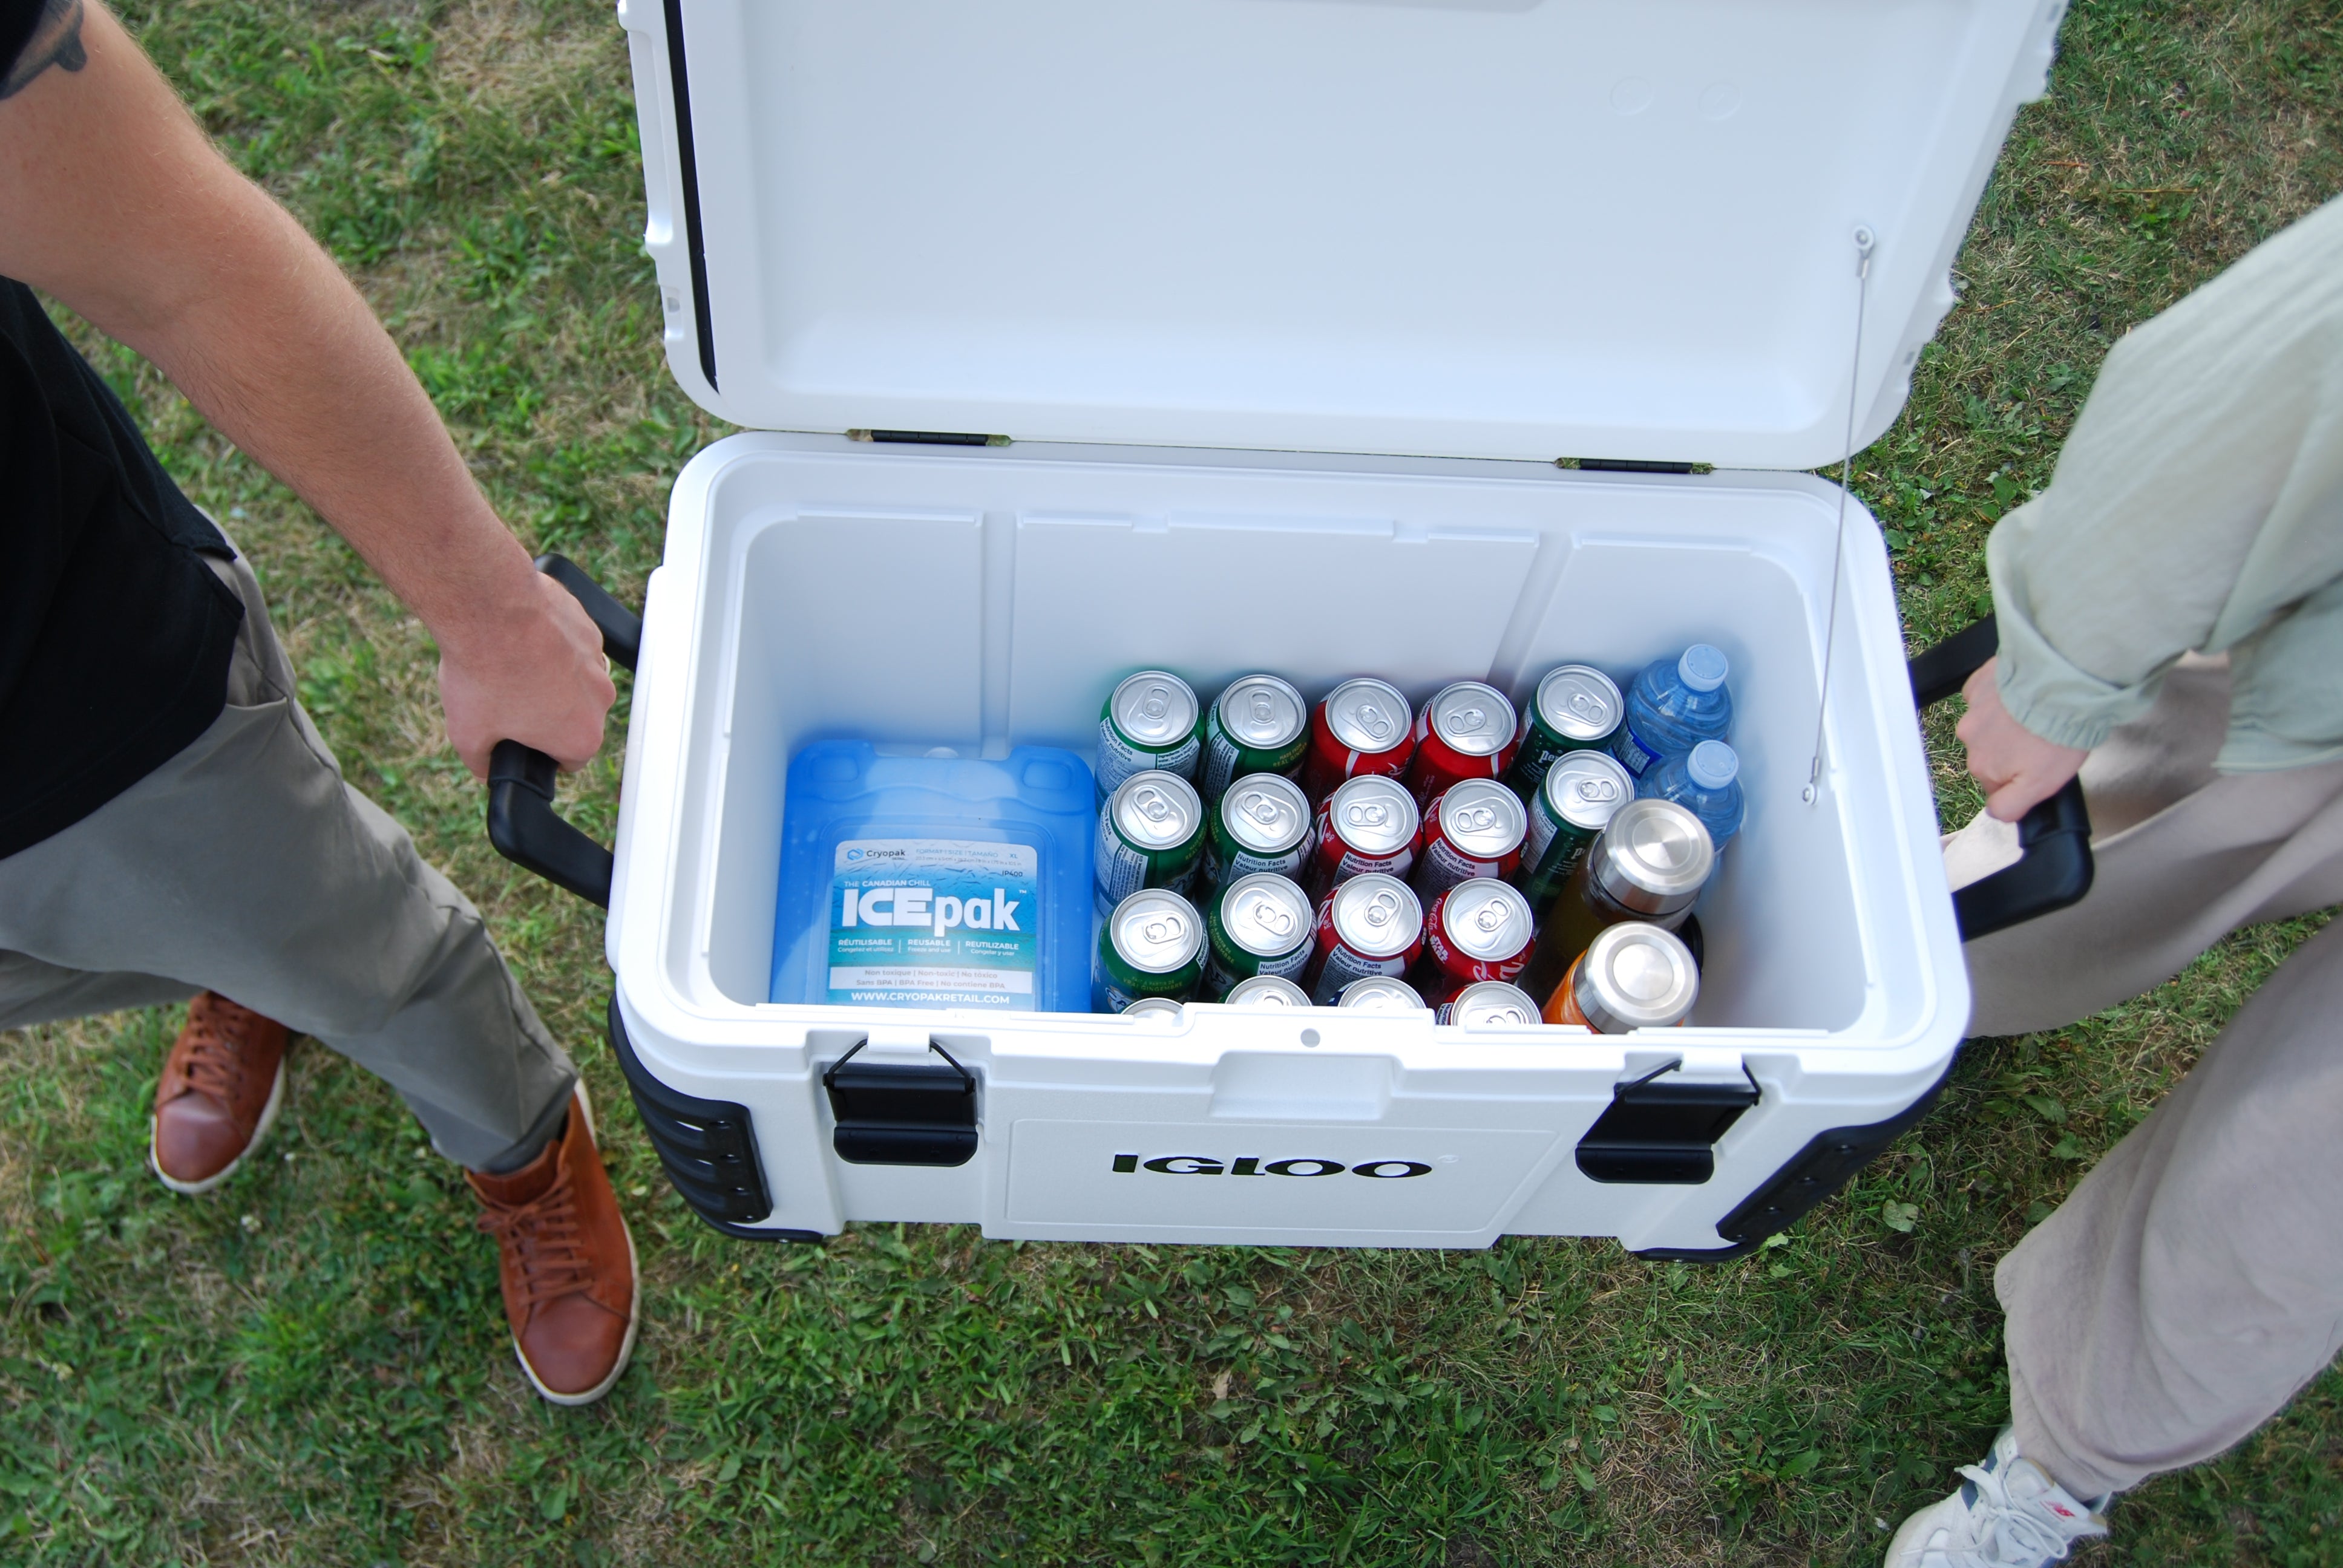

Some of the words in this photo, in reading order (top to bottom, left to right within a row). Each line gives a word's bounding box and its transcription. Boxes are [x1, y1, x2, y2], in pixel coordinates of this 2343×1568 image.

[1104, 719, 1118, 744] Nutrition
[1118, 742, 1133, 756] Facts
[1109, 743, 1132, 762] nutritive
[1273, 759, 1288, 768] REAL
[867, 849, 905, 858] Cryopak
[1237, 854, 1266, 866] Nutrition
[1345, 854, 1373, 867] Nutrition
[1431, 844, 1447, 863] Valeur
[1447, 861, 1475, 877] nutritive
[1436, 839, 1457, 863] Nutrition
[1457, 858, 1475, 870] Facts
[1235, 860, 1257, 872] Valeur
[1342, 860, 1364, 873] Valeur
[842, 887, 1021, 938] ICEpak
[838, 938, 893, 946] RÉUTILISABLE
[965, 941, 1019, 950] REUTILIZABLE
[1259, 967, 1282, 976] Valeur
[1283, 953, 1308, 972] nutritive
[1260, 960, 1289, 970] Nutrition
[1290, 949, 1305, 962] Facts
[1332, 952, 1352, 969] Valeur
[1352, 965, 1383, 976] nutritive
[1335, 946, 1362, 966] Nutrition
[1363, 961, 1381, 969] Facts
[1141, 982, 1183, 992] GINGEMBRE
[851, 992, 1010, 1004] WWW.CRYOPAKRETAIL.COM
[1112, 1154, 1433, 1179] IGLOO
